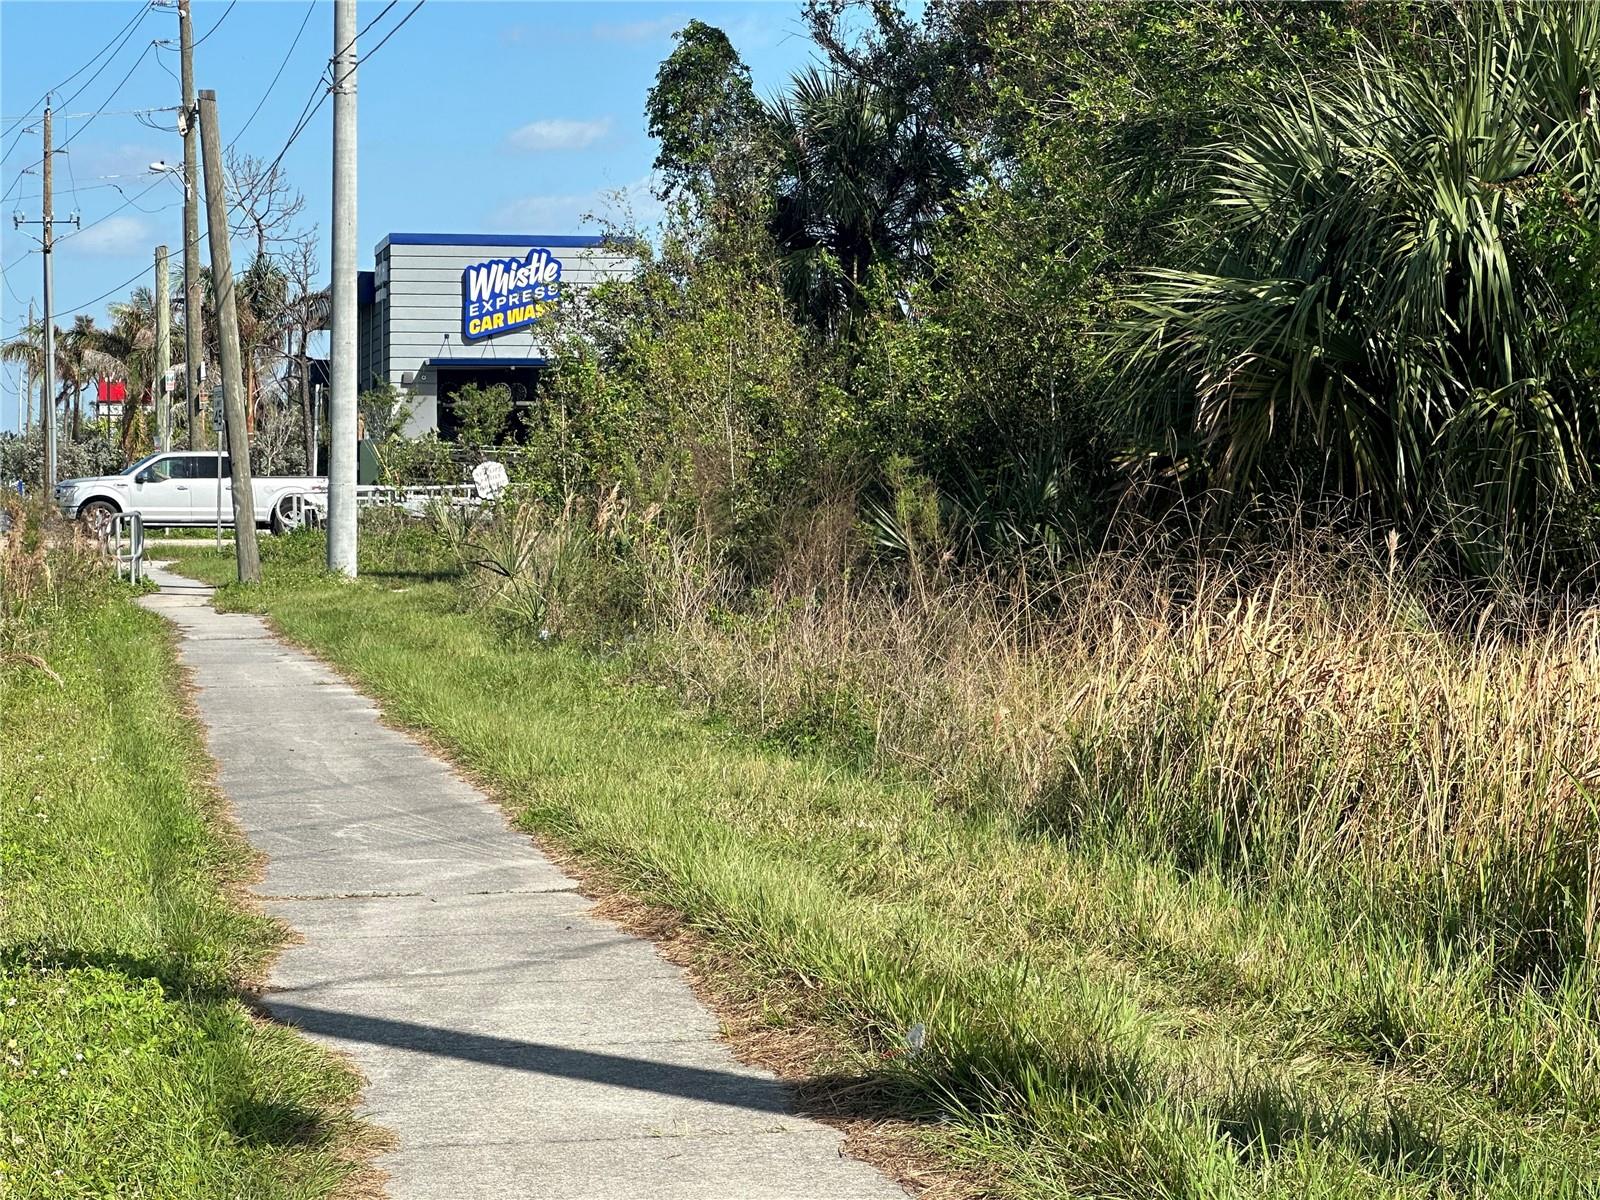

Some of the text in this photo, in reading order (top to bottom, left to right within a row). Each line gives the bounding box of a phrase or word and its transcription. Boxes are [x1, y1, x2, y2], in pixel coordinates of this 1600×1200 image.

[469, 252, 558, 302] Whistle
[469, 283, 559, 317] EXPRESS
[469, 300, 557, 335] CAR WAS
